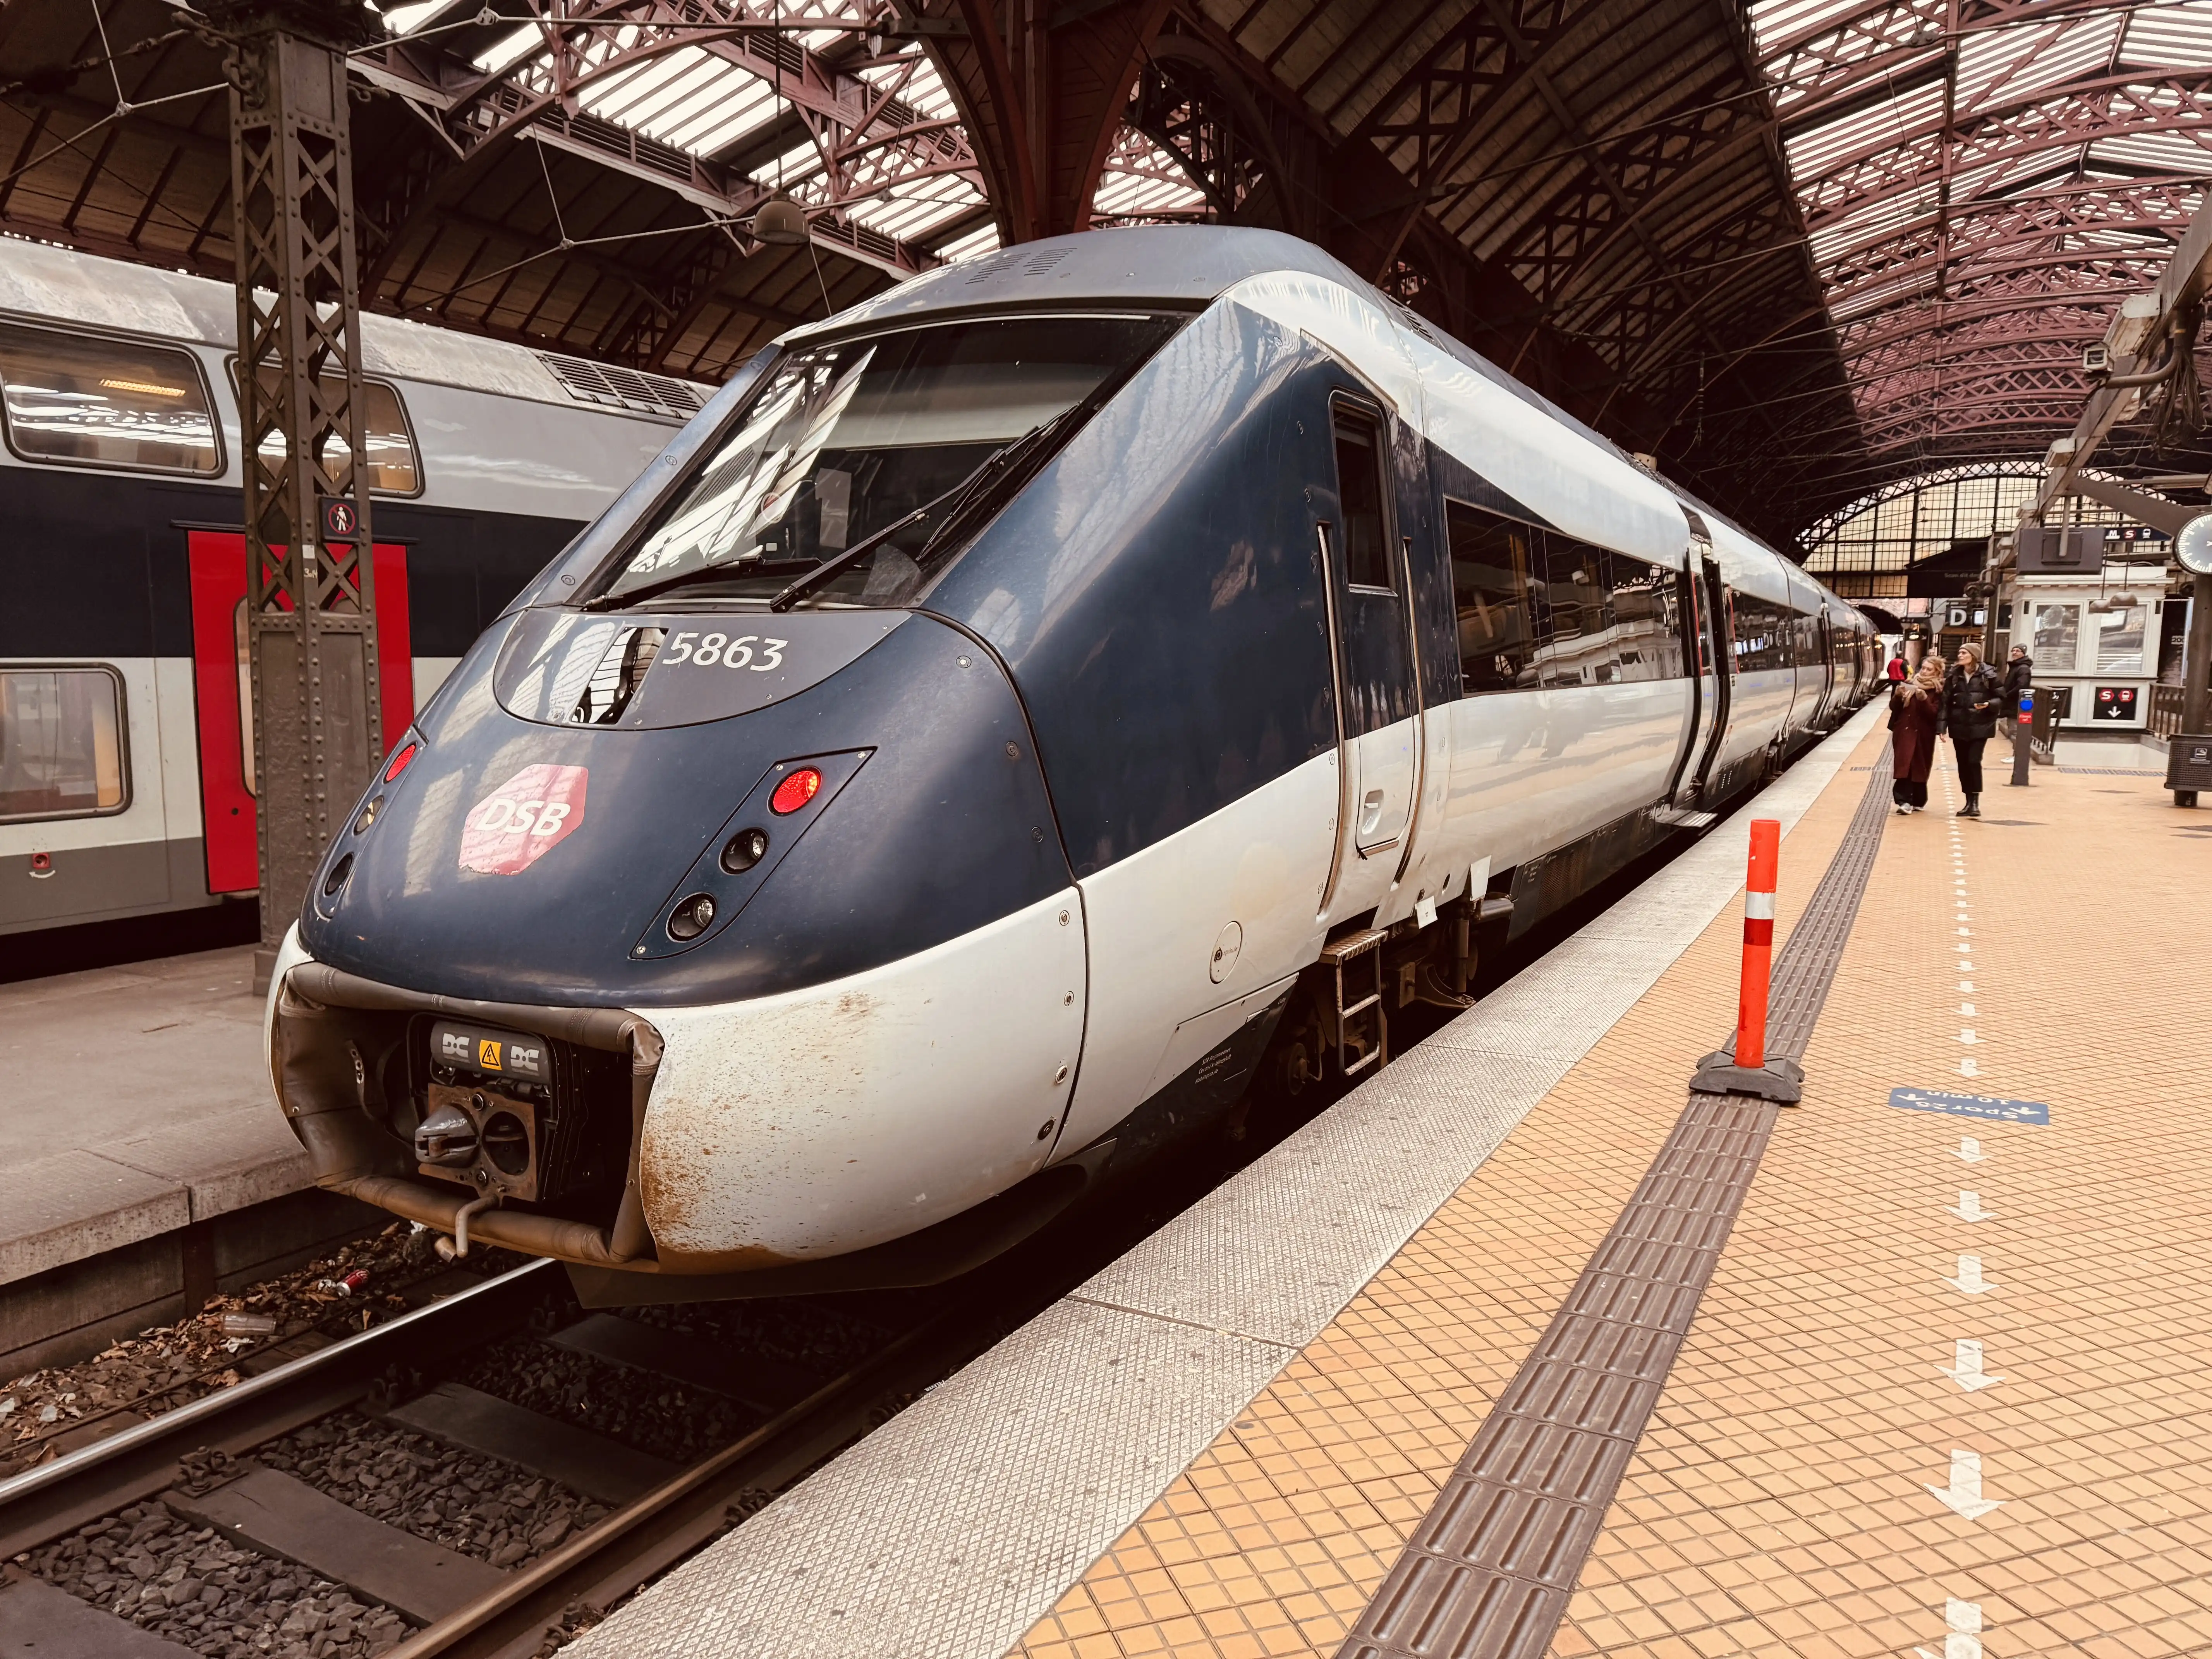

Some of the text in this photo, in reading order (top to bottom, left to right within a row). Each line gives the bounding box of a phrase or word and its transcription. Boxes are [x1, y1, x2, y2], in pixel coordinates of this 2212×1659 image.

[1949, 609, 1967, 626] D
[662, 632, 788, 672] 5863
[2100, 691, 2111, 700] S
[479, 798, 571, 836] DSB
[1927, 1091, 2011, 1105] 10 min
[1952, 1105, 2018, 1119] Spor
